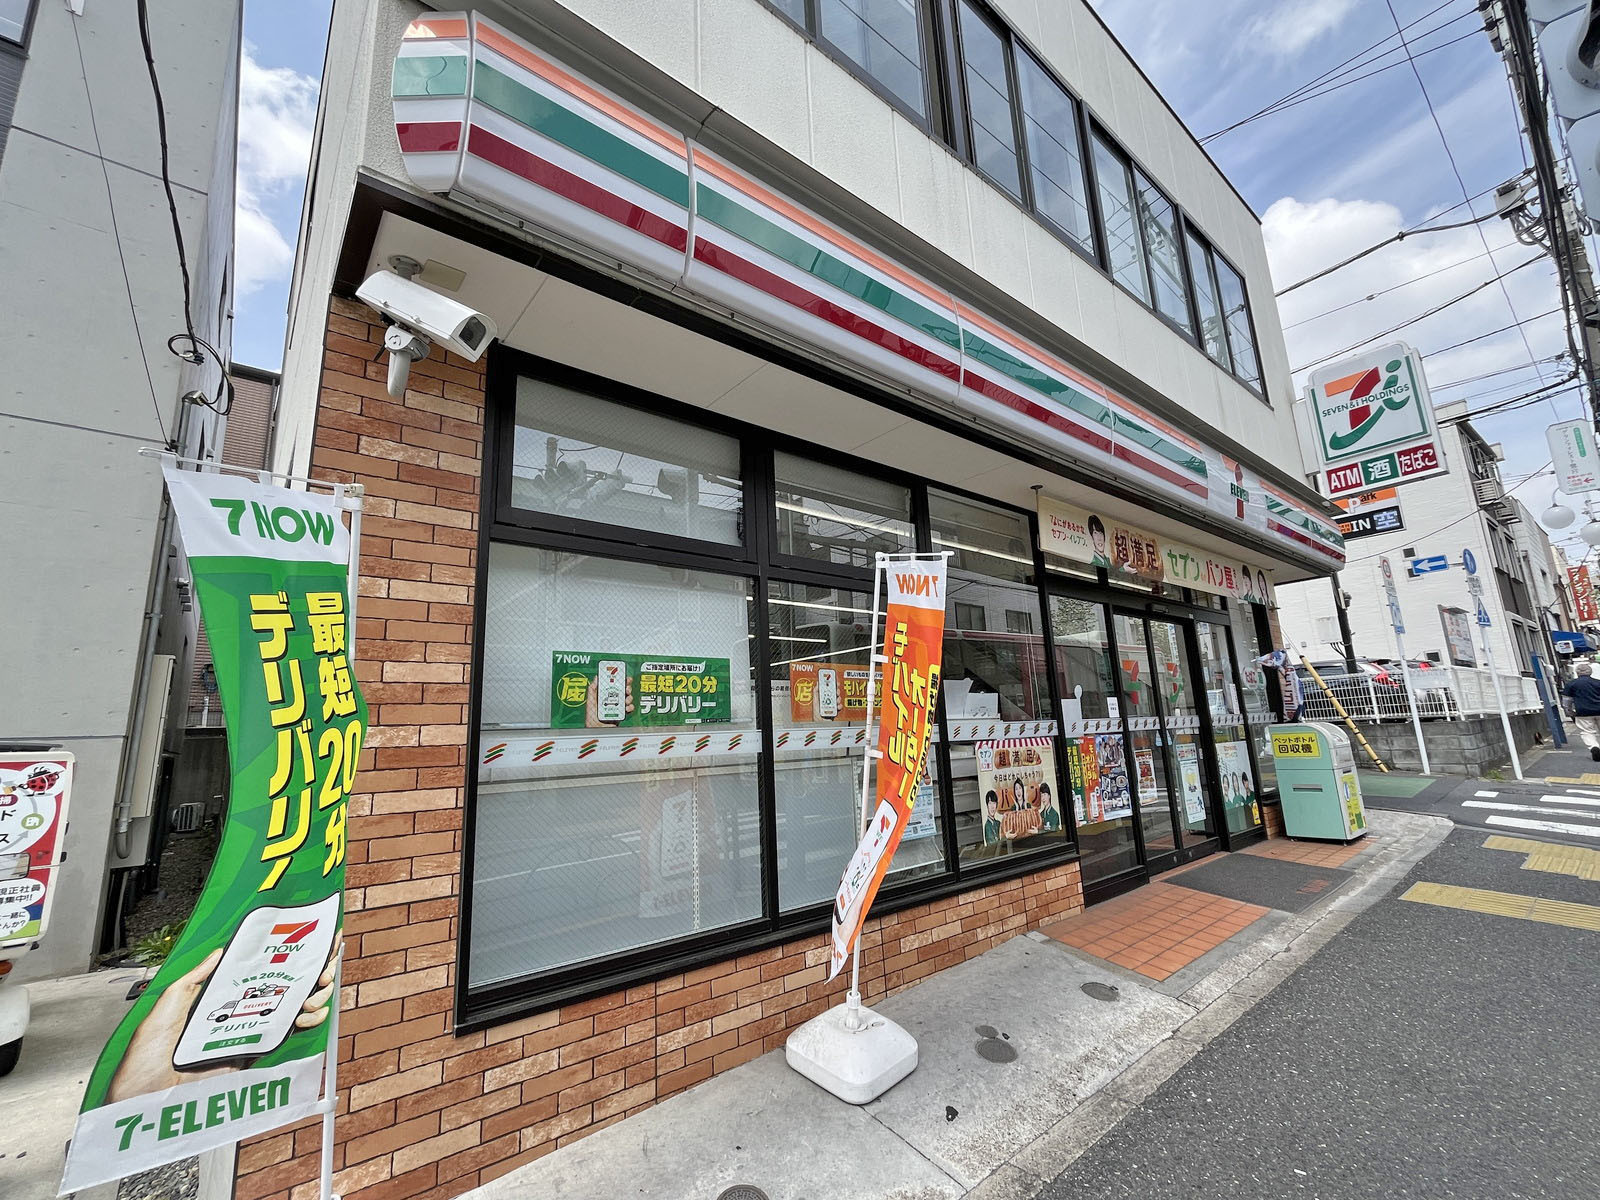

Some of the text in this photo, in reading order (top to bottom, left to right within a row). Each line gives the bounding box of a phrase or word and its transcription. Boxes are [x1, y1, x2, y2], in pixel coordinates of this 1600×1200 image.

[1361, 383, 1410, 405] HOLDINGS
[1367, 459, 1391, 480] 酒
[1400, 448, 1437, 472] たばこ
[1331, 468, 1360, 490] ATM
[210, 498, 334, 547] 7NOW
[1351, 518, 1371, 532] IN
[1373, 511, 1400, 530] 空
[1115, 532, 1159, 571] 超満足
[555, 654, 590, 664] 7NOW
[640, 674, 718, 693] 最短20分
[794, 681, 814, 702] 店
[640, 695, 716, 714] デリバリー
[249, 590, 313, 892] デリバリー
[305, 591, 362, 878] 最短20分
[1278, 744, 1313, 754] 回収機
[1088, 744, 1097, 780] モバイル
[0, 911, 26, 919] 一緒に
[243, 1001, 273, 1010] DELIVERY
[210, 1021, 270, 1035] デリバリー
